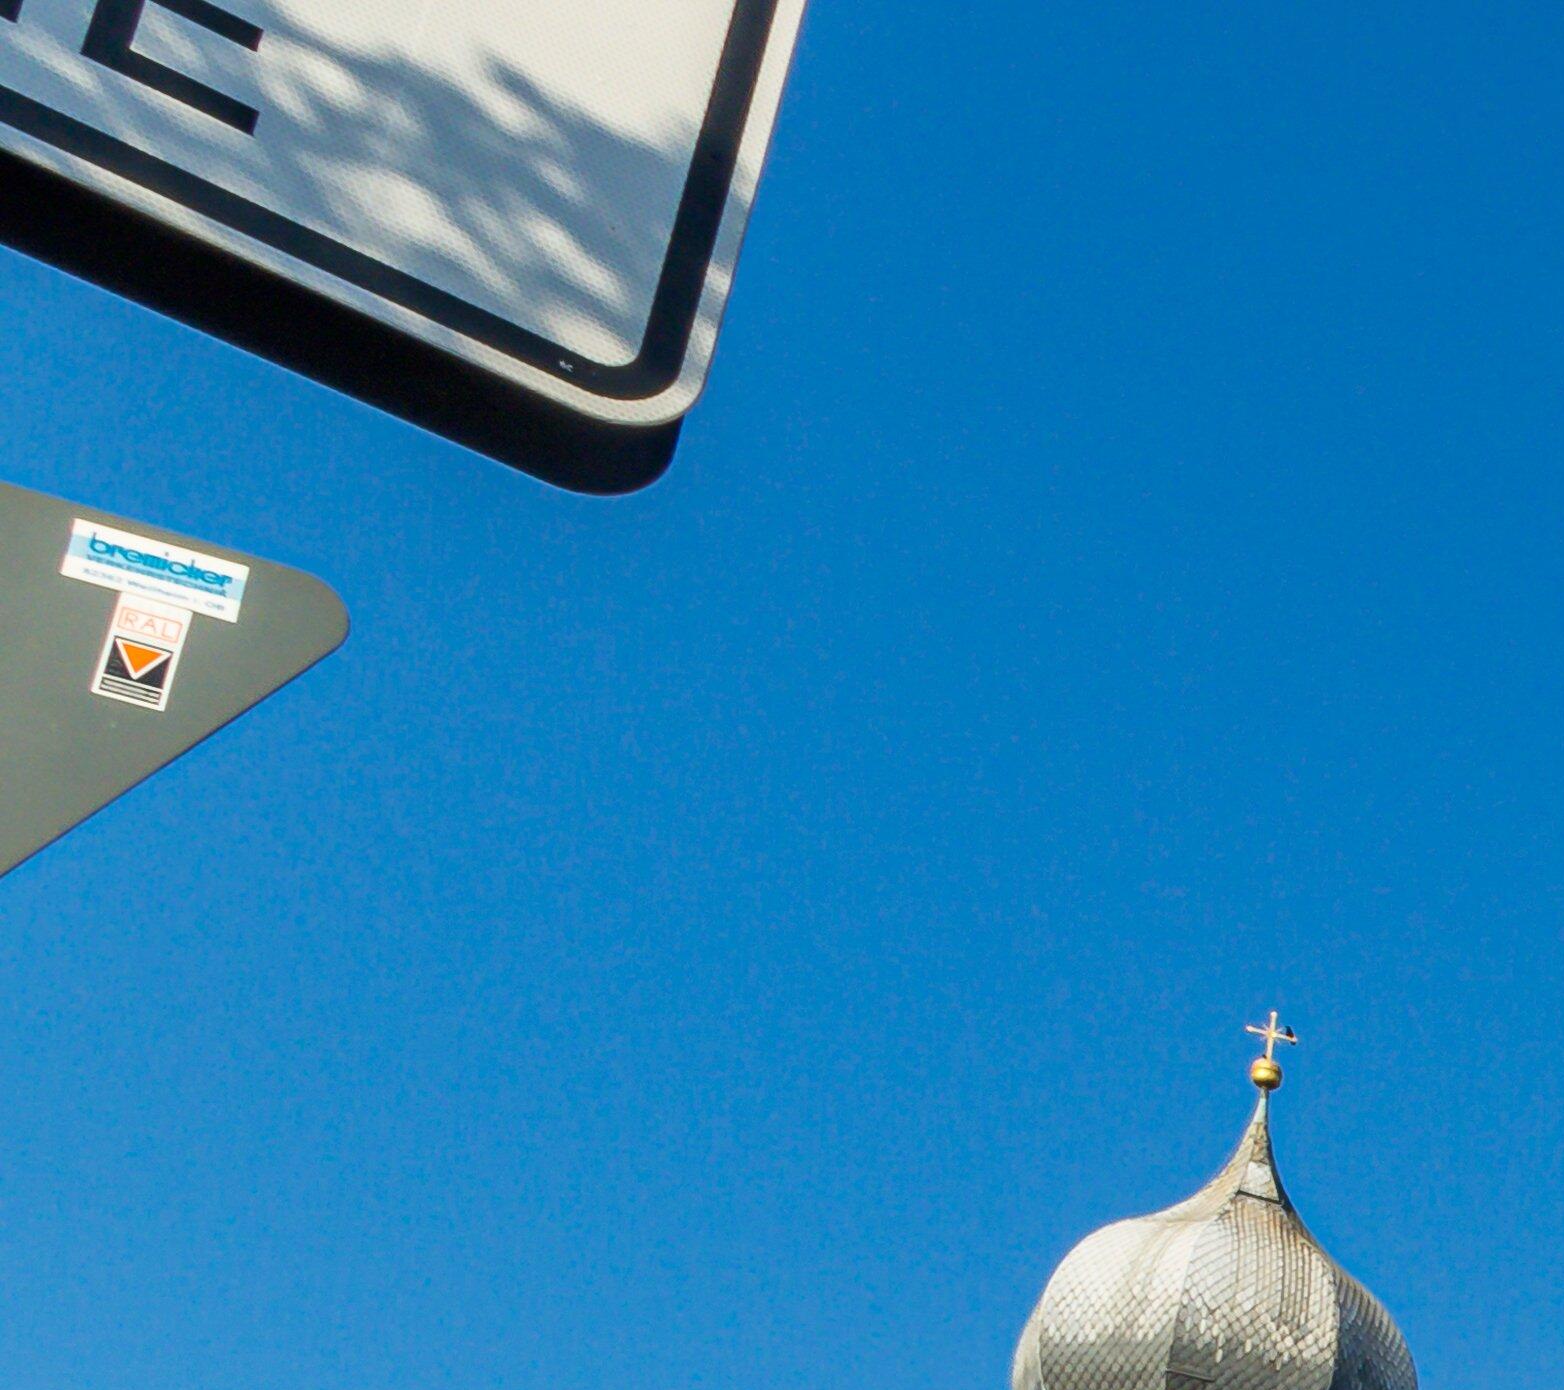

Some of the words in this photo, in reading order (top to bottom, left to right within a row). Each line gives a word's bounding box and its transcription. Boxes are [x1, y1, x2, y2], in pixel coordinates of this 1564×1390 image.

[0, 0, 263, 136] E
[88, 532, 234, 587] bremicker
[124, 612, 176, 639] RAL
